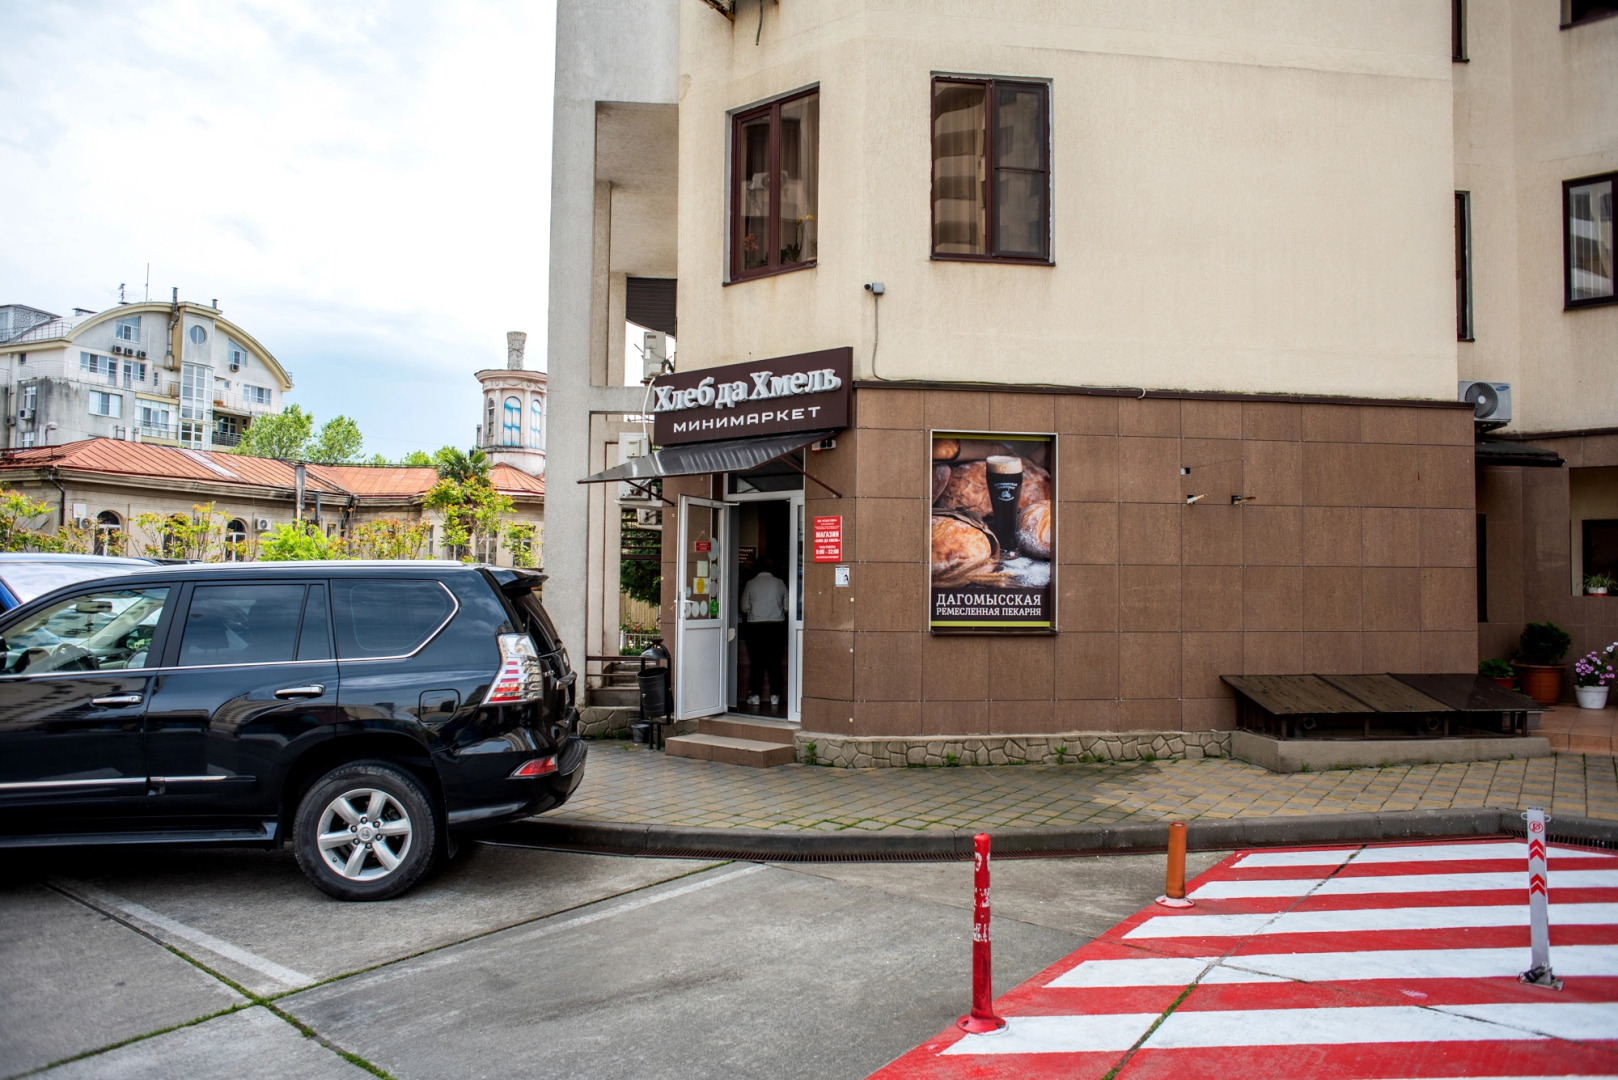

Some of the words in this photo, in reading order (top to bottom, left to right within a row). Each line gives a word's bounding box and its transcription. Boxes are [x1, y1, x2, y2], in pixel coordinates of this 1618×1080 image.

[653, 376, 716, 413] Хлеб
[715, 380, 749, 410] да
[749, 368, 842, 400] Хмель
[673, 406, 821, 433] МИНИМАРКЕТ
[936, 593, 1042, 607] ДАГОМЫССКАЯ
[936, 607, 1000, 616] РЕМЕСЛЕННАЯ
[1002, 607, 1042, 616] ПЕКАРНЯ
